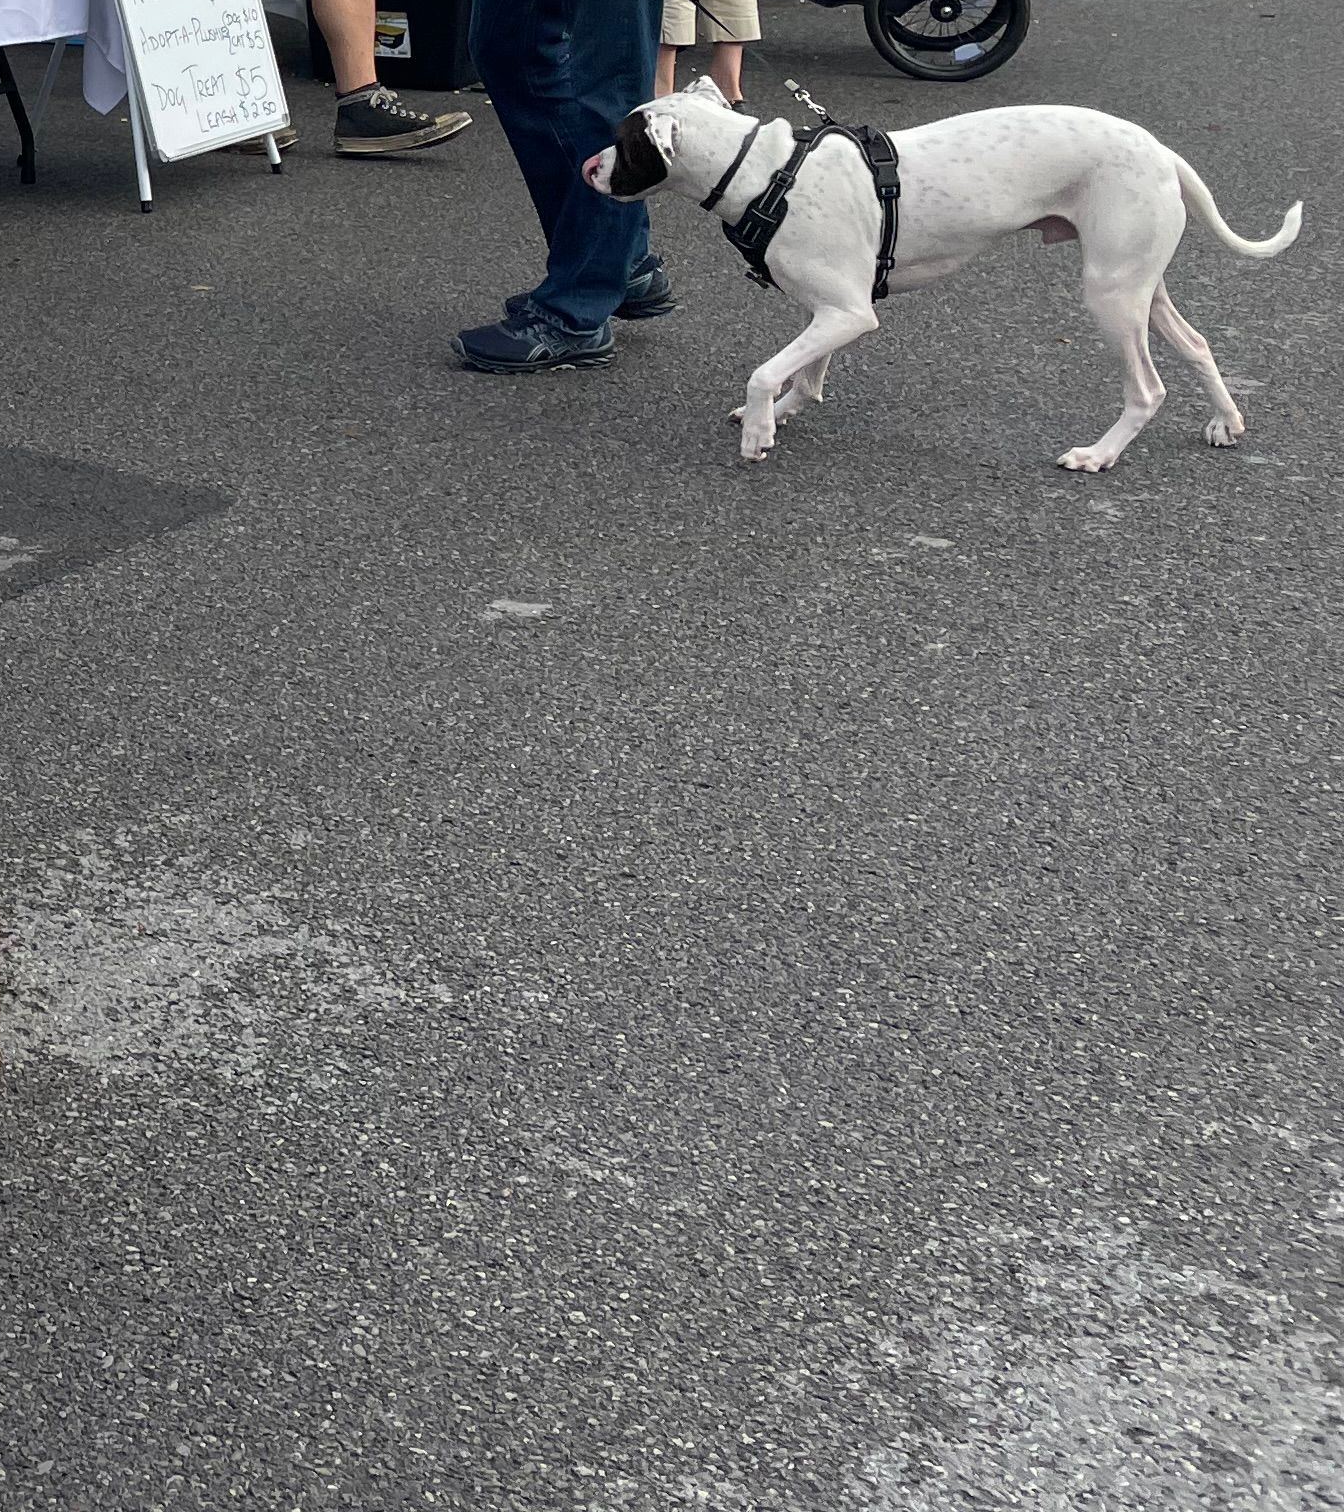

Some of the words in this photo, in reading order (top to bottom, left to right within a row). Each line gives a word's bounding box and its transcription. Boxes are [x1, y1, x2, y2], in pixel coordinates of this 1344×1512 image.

[151, 82, 188, 113] DOG
[181, 64, 228, 103] TREAT
[235, 64, 269, 101] $5
[195, 105, 239, 133] LEASH
